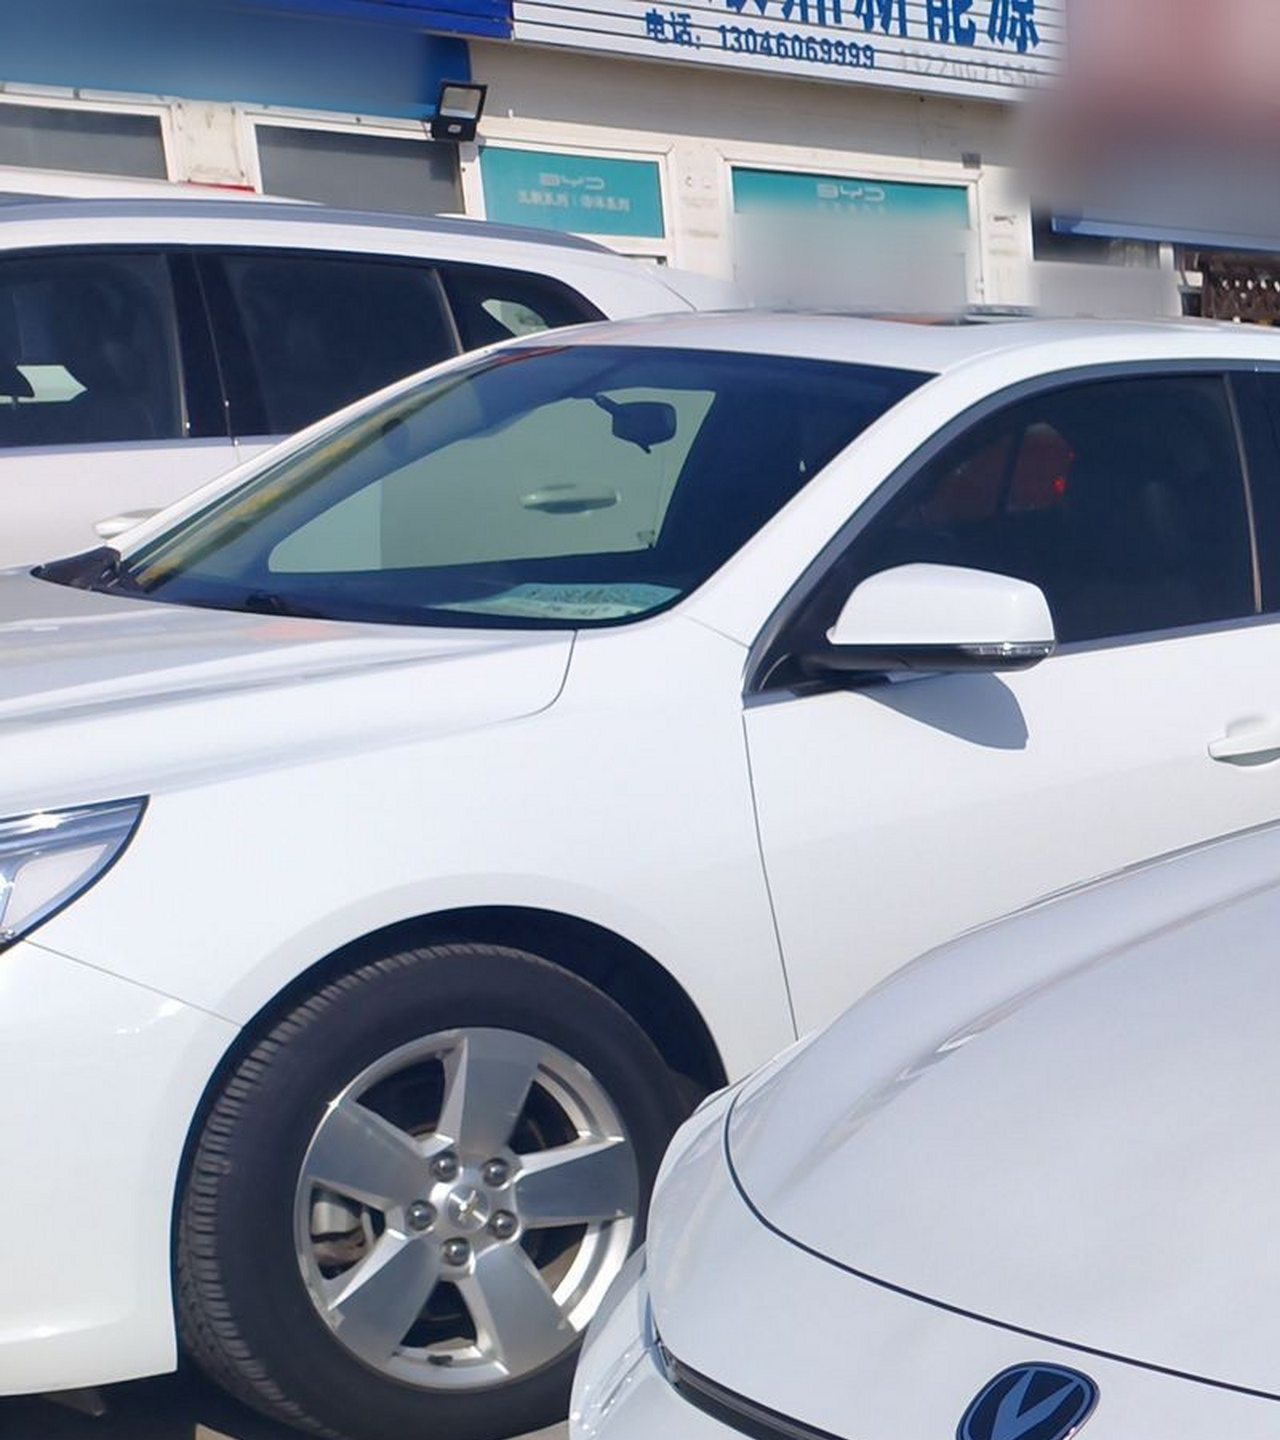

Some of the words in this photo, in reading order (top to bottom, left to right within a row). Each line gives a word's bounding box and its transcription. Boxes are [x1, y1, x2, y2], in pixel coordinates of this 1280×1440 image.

[718, 24, 875, 69] 13046069999
[539, 172, 606, 191] BYD
[815, 182, 886, 202] BYD
